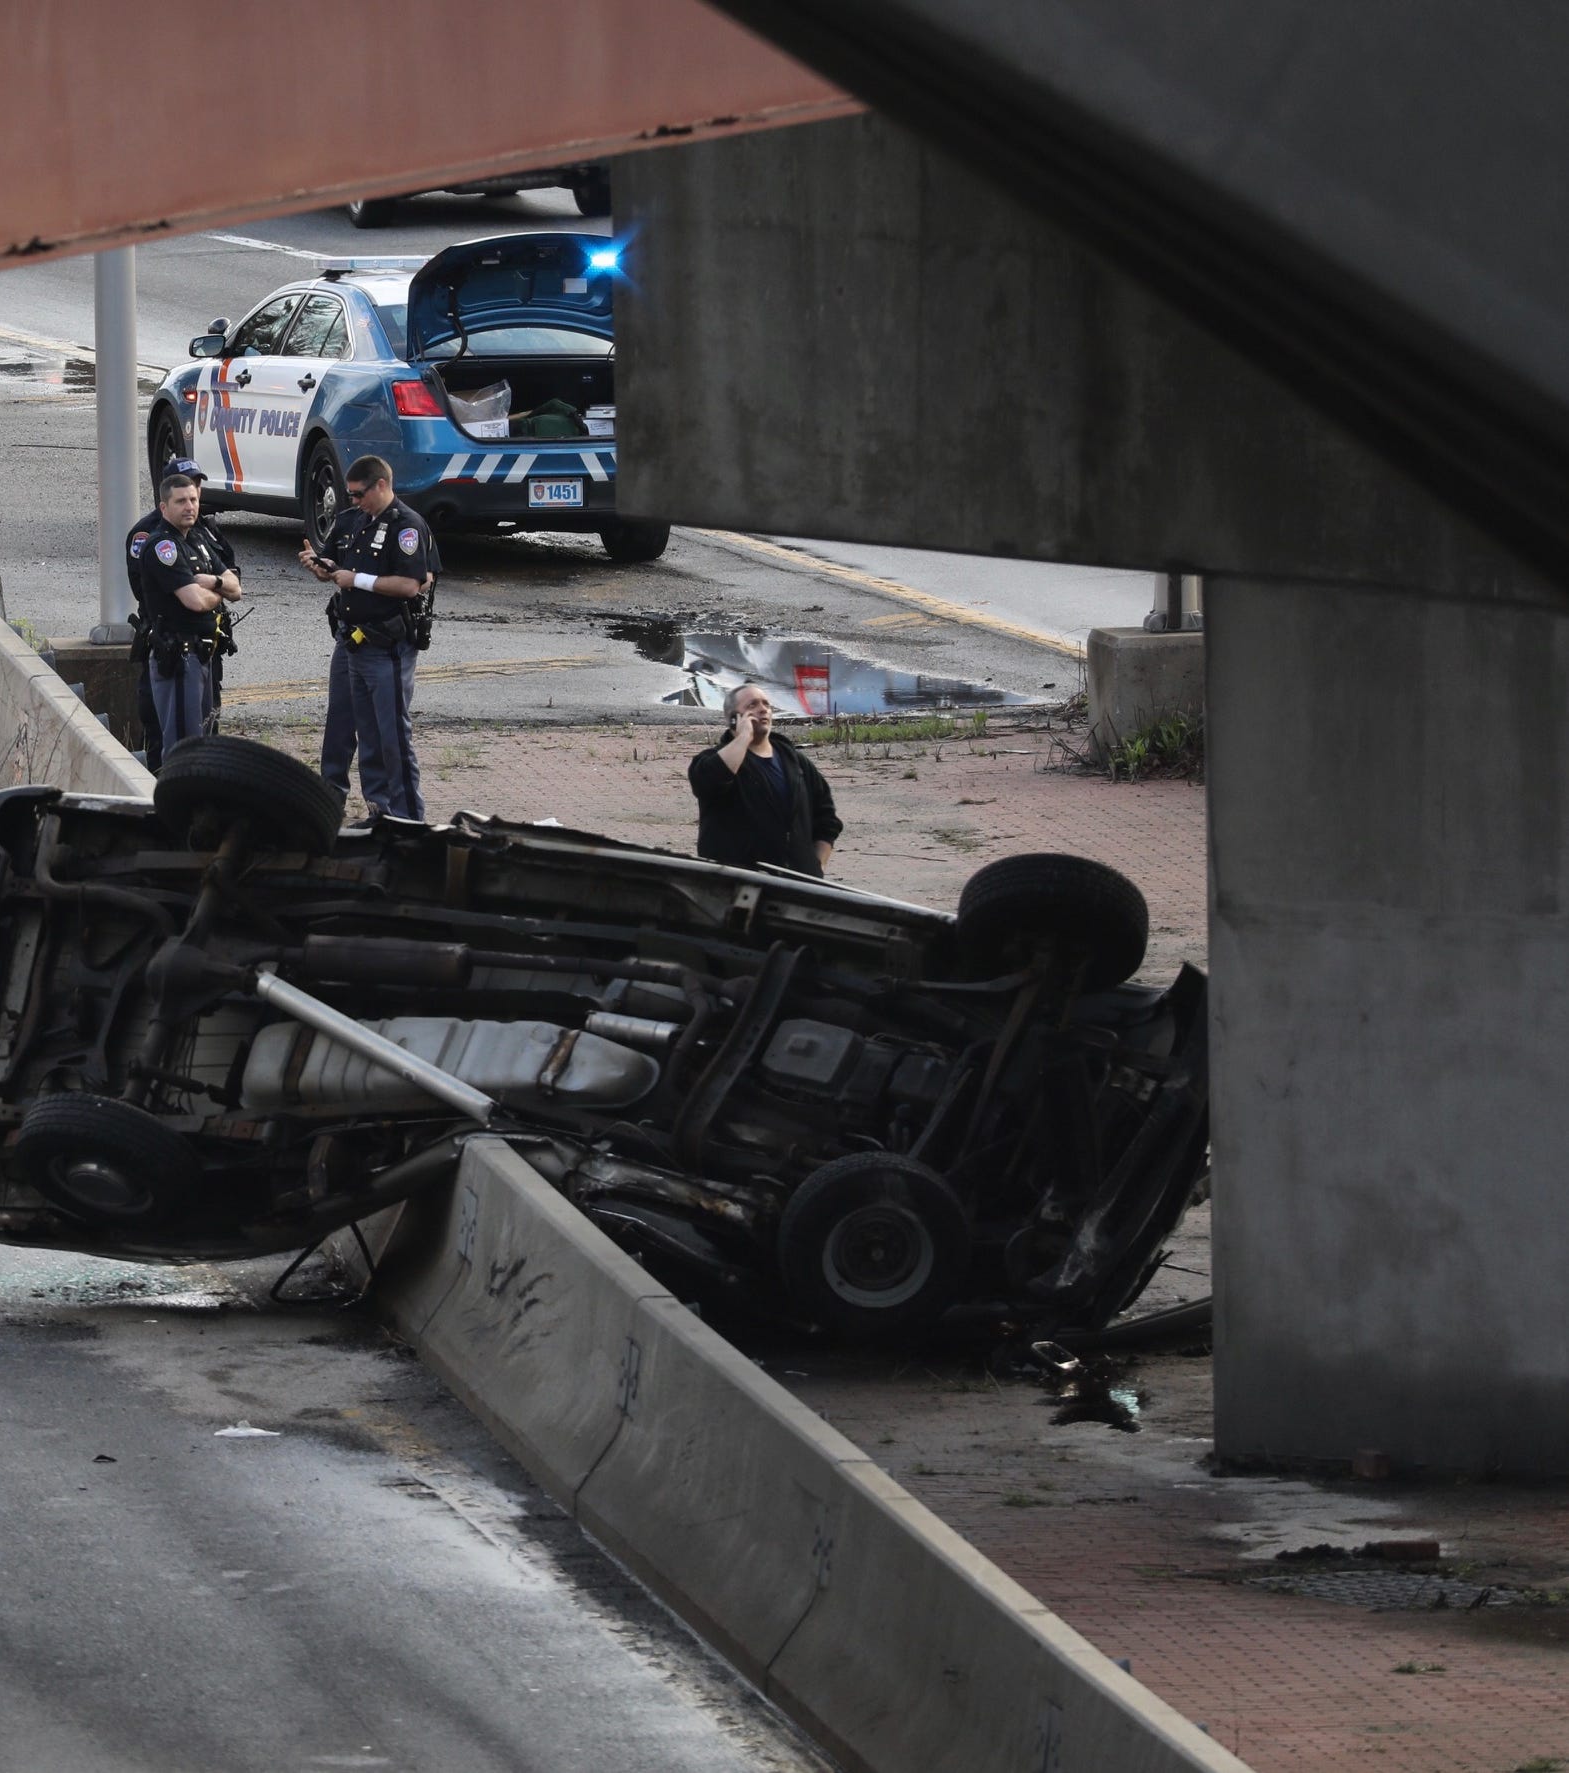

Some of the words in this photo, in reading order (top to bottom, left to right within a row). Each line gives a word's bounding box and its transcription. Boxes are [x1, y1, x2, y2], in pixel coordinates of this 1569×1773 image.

[210, 406, 257, 434] COUNTY
[258, 409, 302, 438] POLICE
[547, 484, 577, 500] 1451
